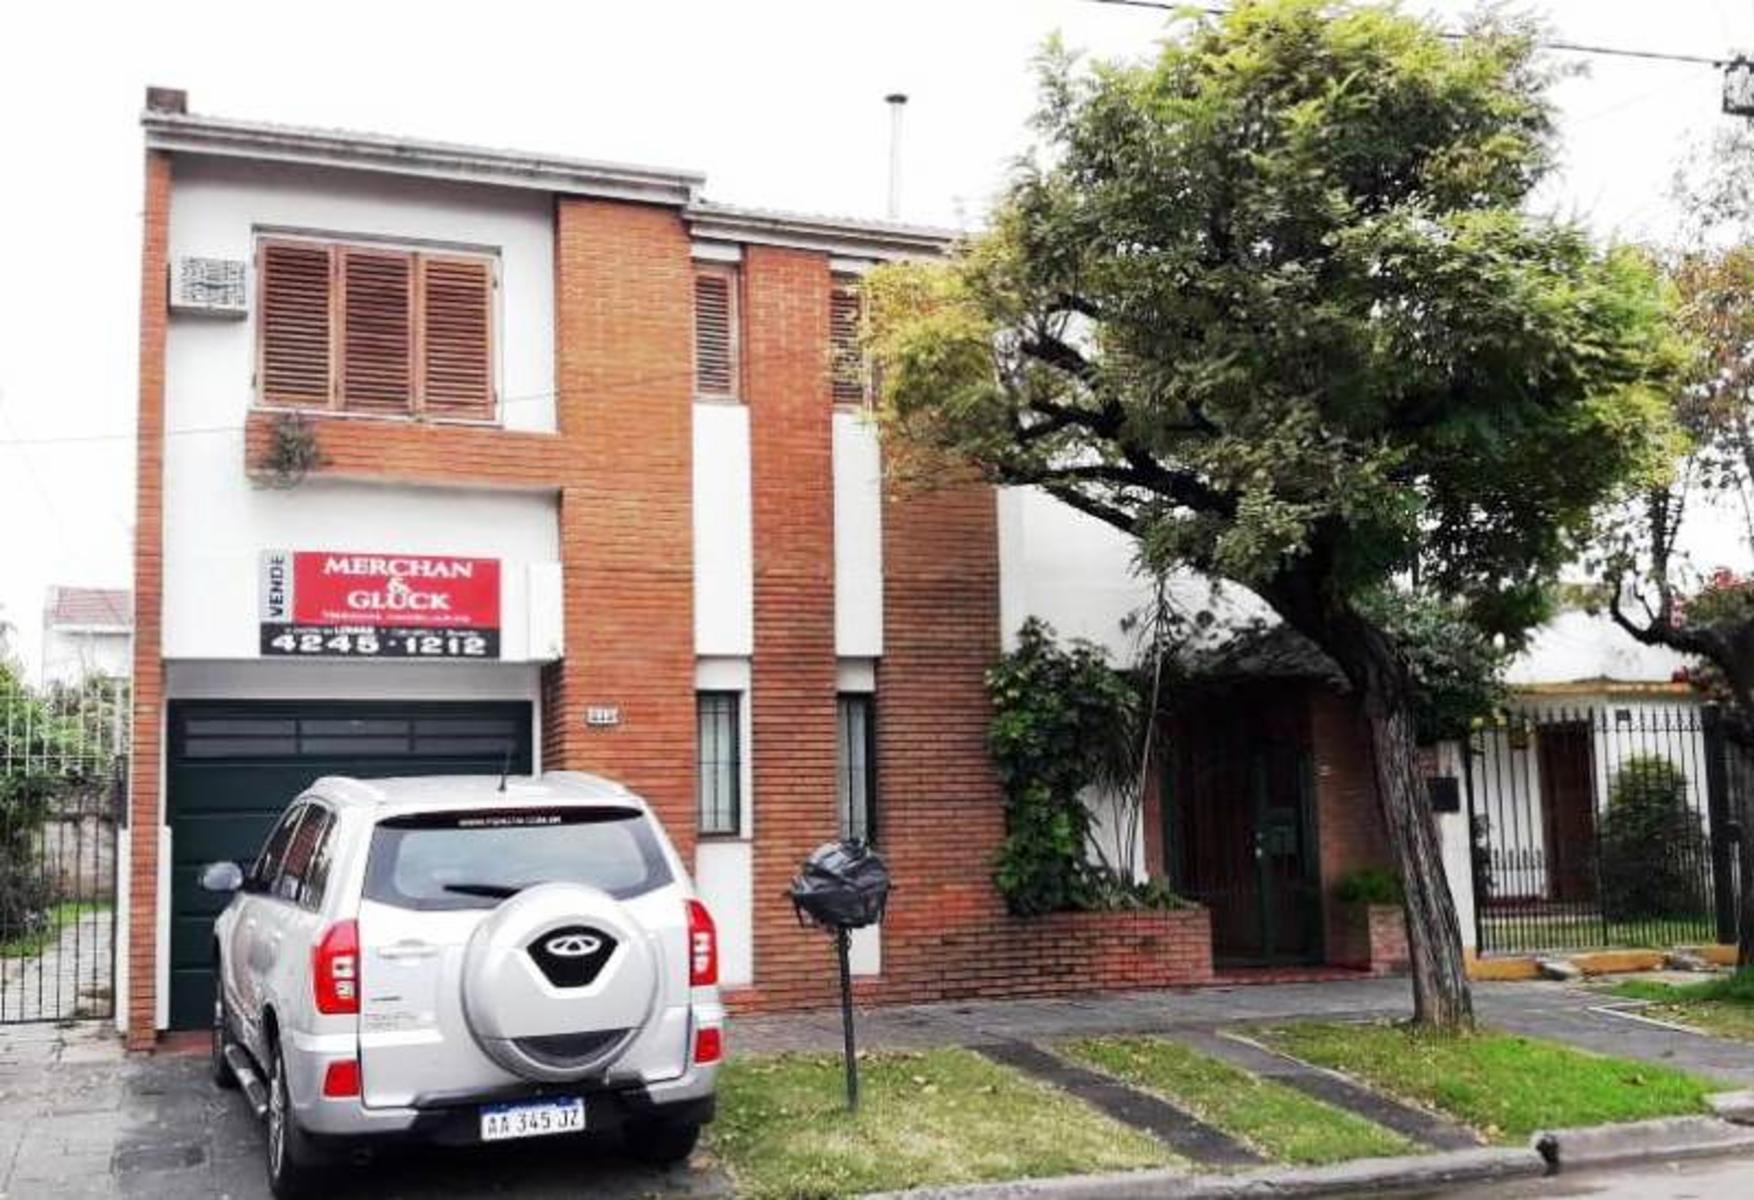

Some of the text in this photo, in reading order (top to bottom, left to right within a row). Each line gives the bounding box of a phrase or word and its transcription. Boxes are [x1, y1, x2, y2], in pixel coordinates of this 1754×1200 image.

[322, 556, 474, 579] MERCHAN
[268, 554, 285, 618] VENDE
[386, 576, 413, 595] &
[487, 1115, 510, 1135] AA
